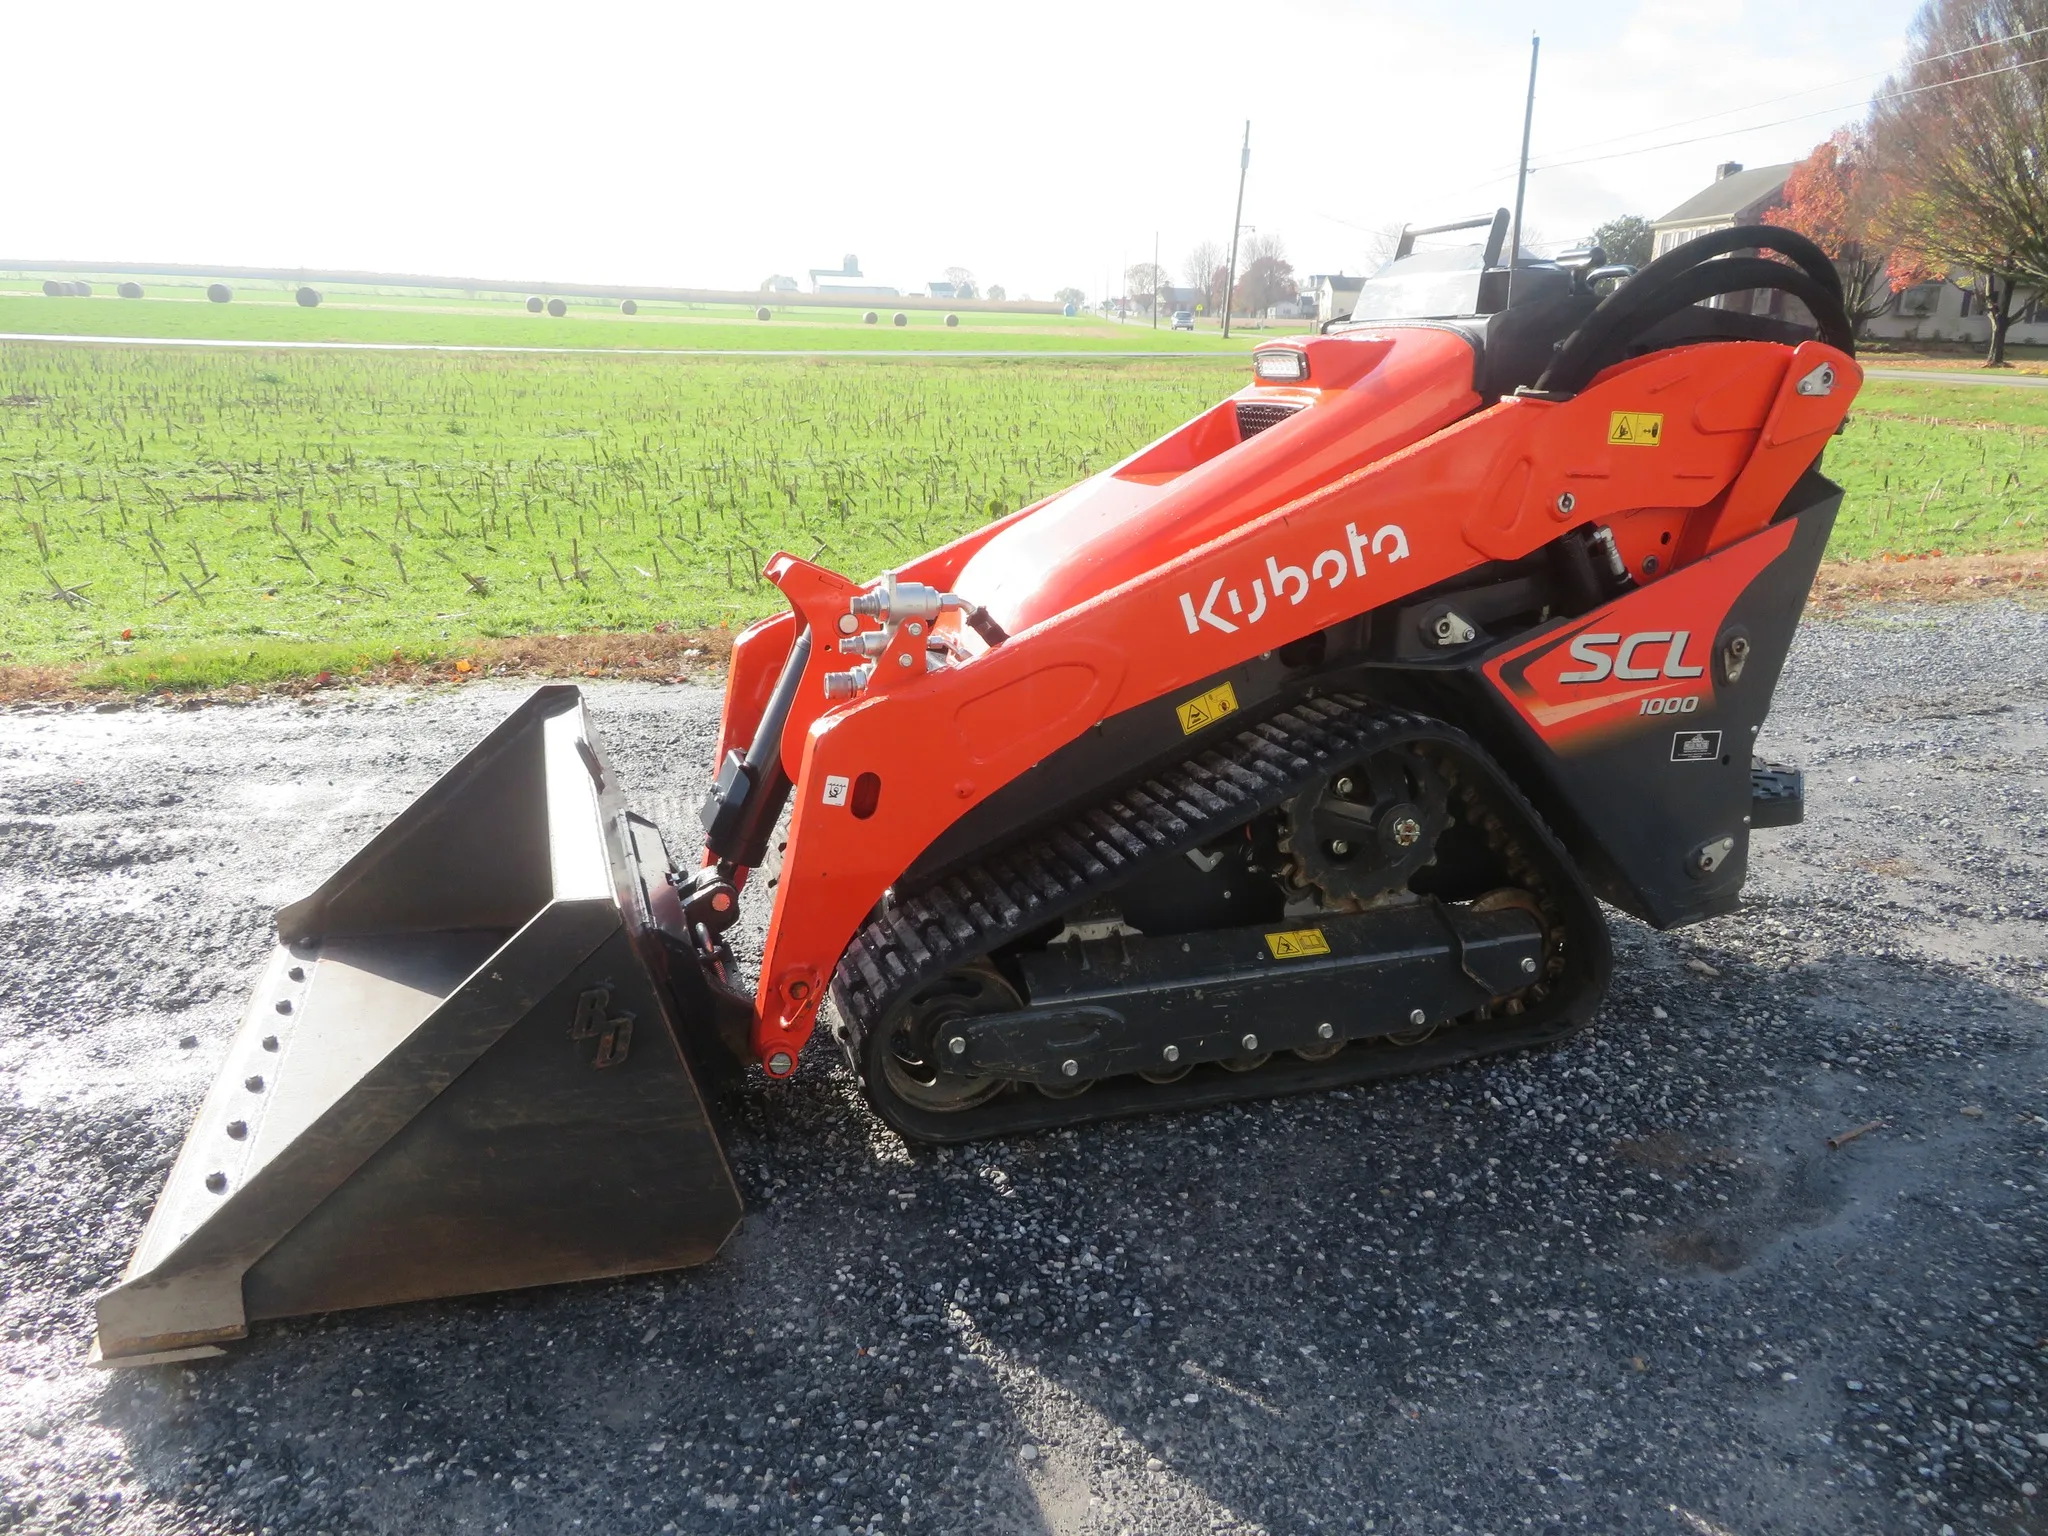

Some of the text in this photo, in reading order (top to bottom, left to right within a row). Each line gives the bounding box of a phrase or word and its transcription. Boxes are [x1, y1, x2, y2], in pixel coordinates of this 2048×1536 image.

[1179, 522, 1410, 634] Kubota
[1558, 631, 1704, 683] SCL
[1639, 696, 1699, 715] 1000
